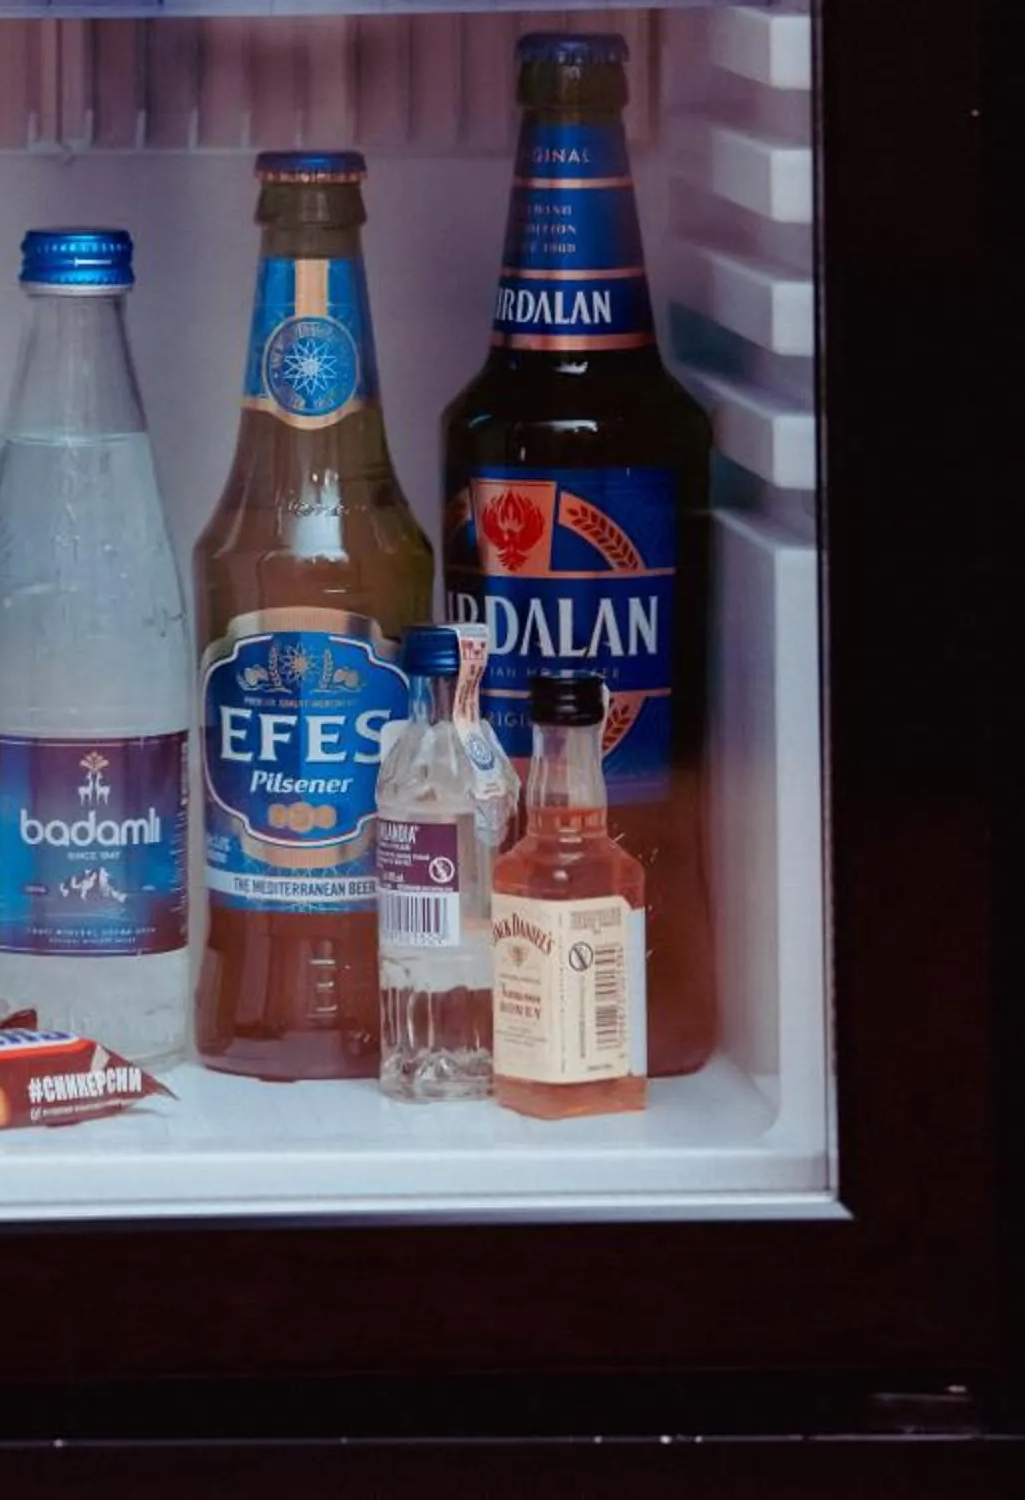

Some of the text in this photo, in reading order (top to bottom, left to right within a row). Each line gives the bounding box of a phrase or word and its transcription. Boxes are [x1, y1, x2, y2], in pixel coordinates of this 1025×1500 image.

[219, 705, 393, 765] EFES
[250, 769, 354, 795] Pilsener
[233, 877, 250, 890] THE
[252, 879, 346, 897] MEDITERRANEAN
